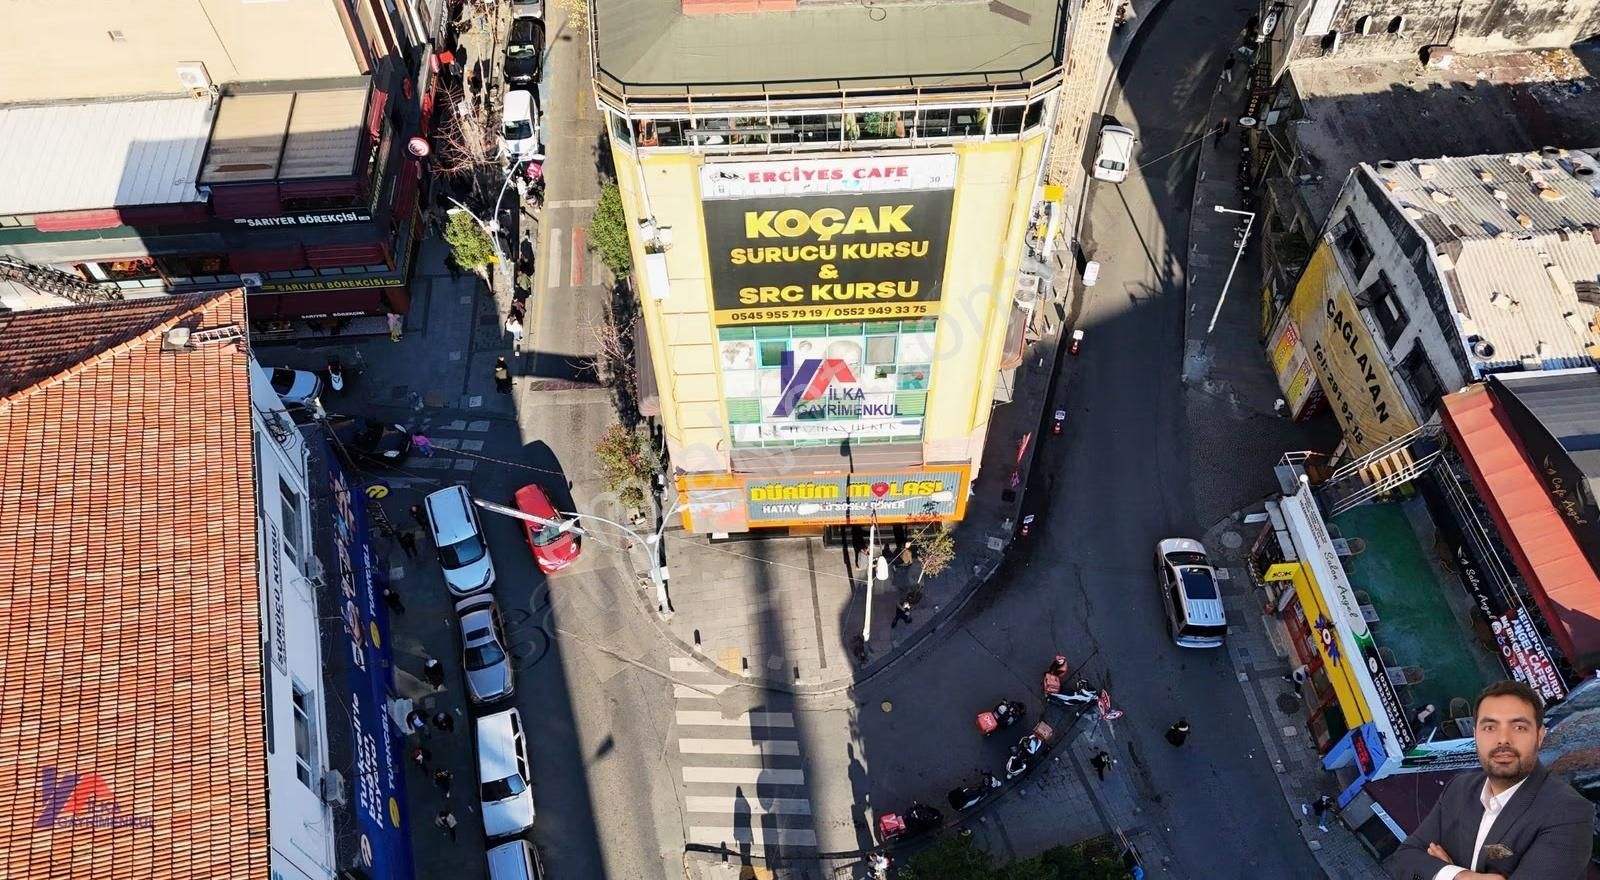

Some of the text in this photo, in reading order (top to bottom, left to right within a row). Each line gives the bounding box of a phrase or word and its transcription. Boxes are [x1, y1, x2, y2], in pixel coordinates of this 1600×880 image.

[749, 166, 909, 183] ERCİYES CAFE
[247, 216, 296, 227] SARIYER
[298, 212, 358, 224] BÖREKÇİSİ
[744, 204, 914, 242] KOÇAK
[842, 240, 929, 260] KURSU
[278, 282, 324, 292] SARIYER
[818, 264, 839, 280] &
[739, 280, 919, 304] SRC KURSU
[732, 312, 763, 320] 0545
[834, 308, 865, 316] 0552
[868, 306, 892, 315] 949
[912, 305, 927, 313] 75
[1326, 298, 1390, 424] ÇAĞLAYAN
[1313, 341, 1328, 371] Tel:
[1328, 374, 1342, 400] 291
[1352, 426, 1364, 444] 18
[763, 504, 798, 514] HATAY
[270, 525, 281, 586] KURSU
[1338, 584, 1358, 620] Angel
[1466, 568, 1498, 620] Salon Angel
[1511, 618, 1533, 654] ANGEL
[381, 704, 395, 790] TURKCELL
